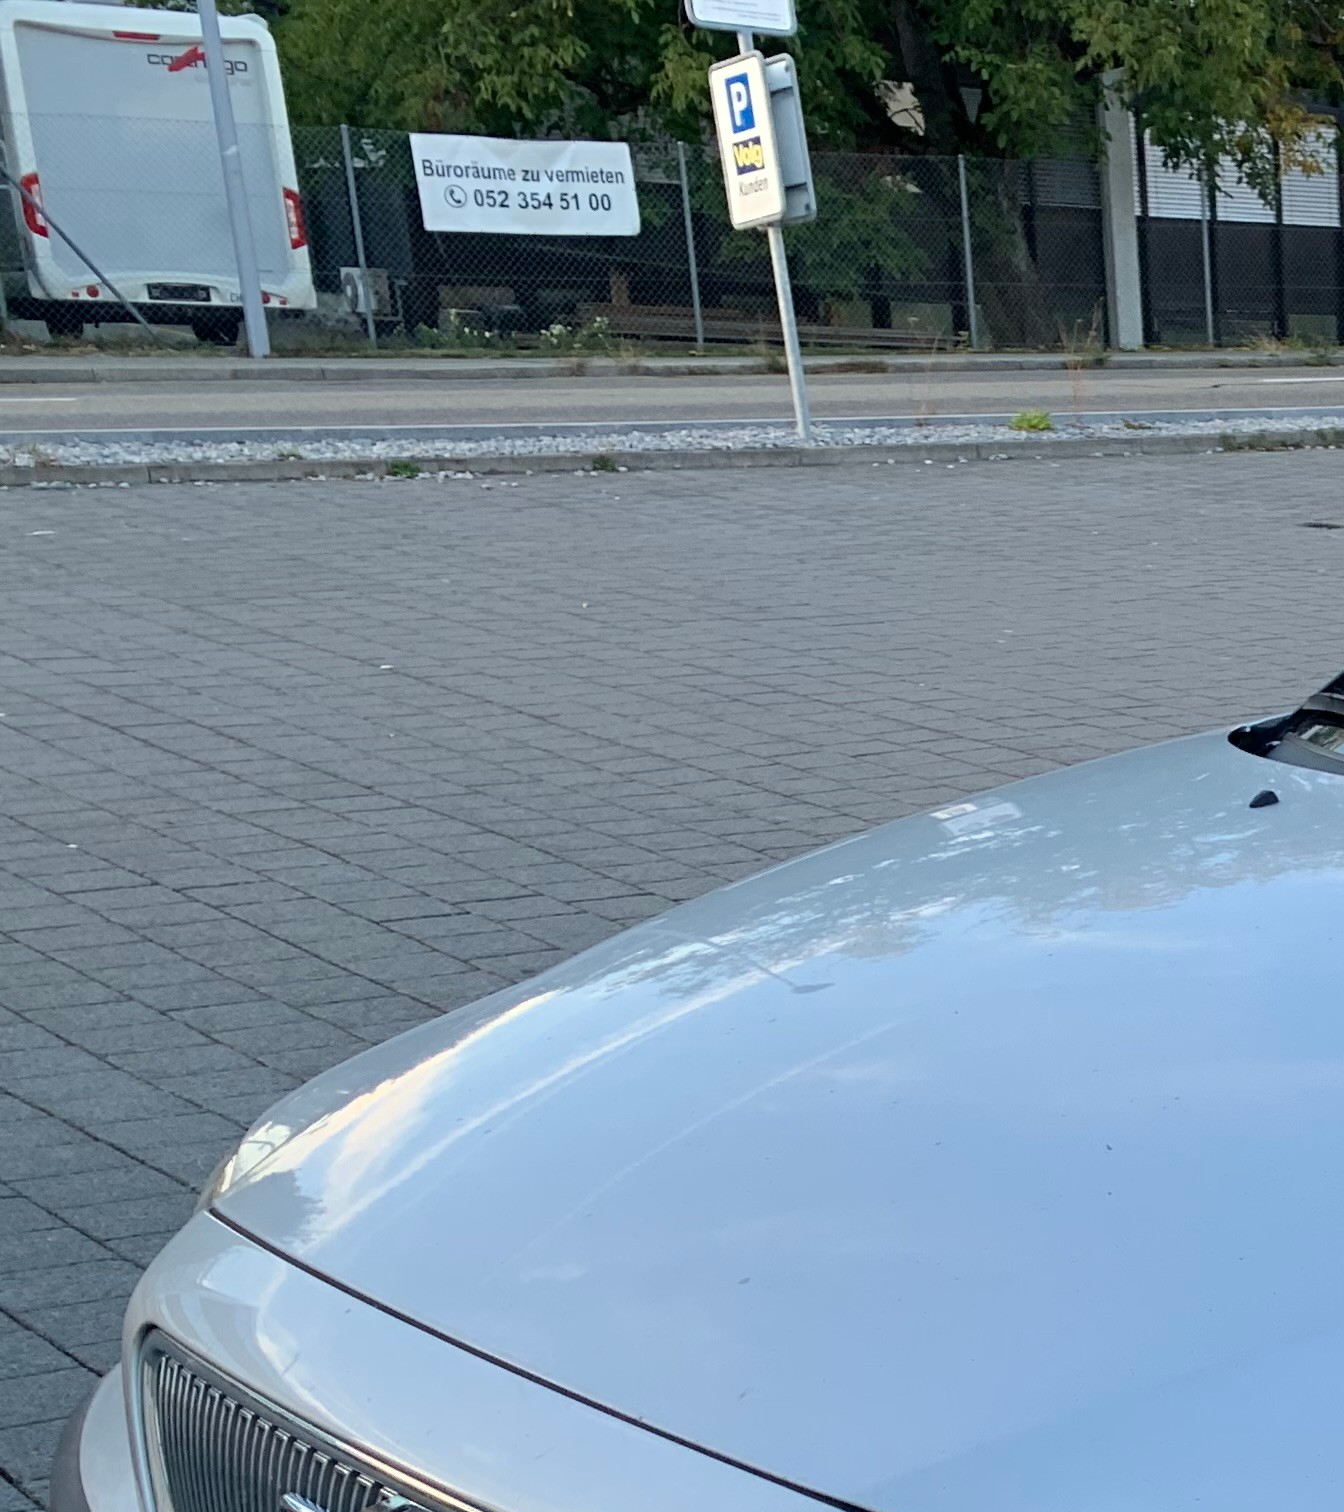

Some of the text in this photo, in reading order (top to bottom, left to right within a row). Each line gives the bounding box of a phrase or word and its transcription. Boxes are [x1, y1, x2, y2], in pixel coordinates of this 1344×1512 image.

[729, 81, 748, 127] P
[732, 140, 764, 169] Volg
[421, 159, 625, 184] Büroräume zu vermieten
[474, 189, 612, 211] 052 354 51 00
